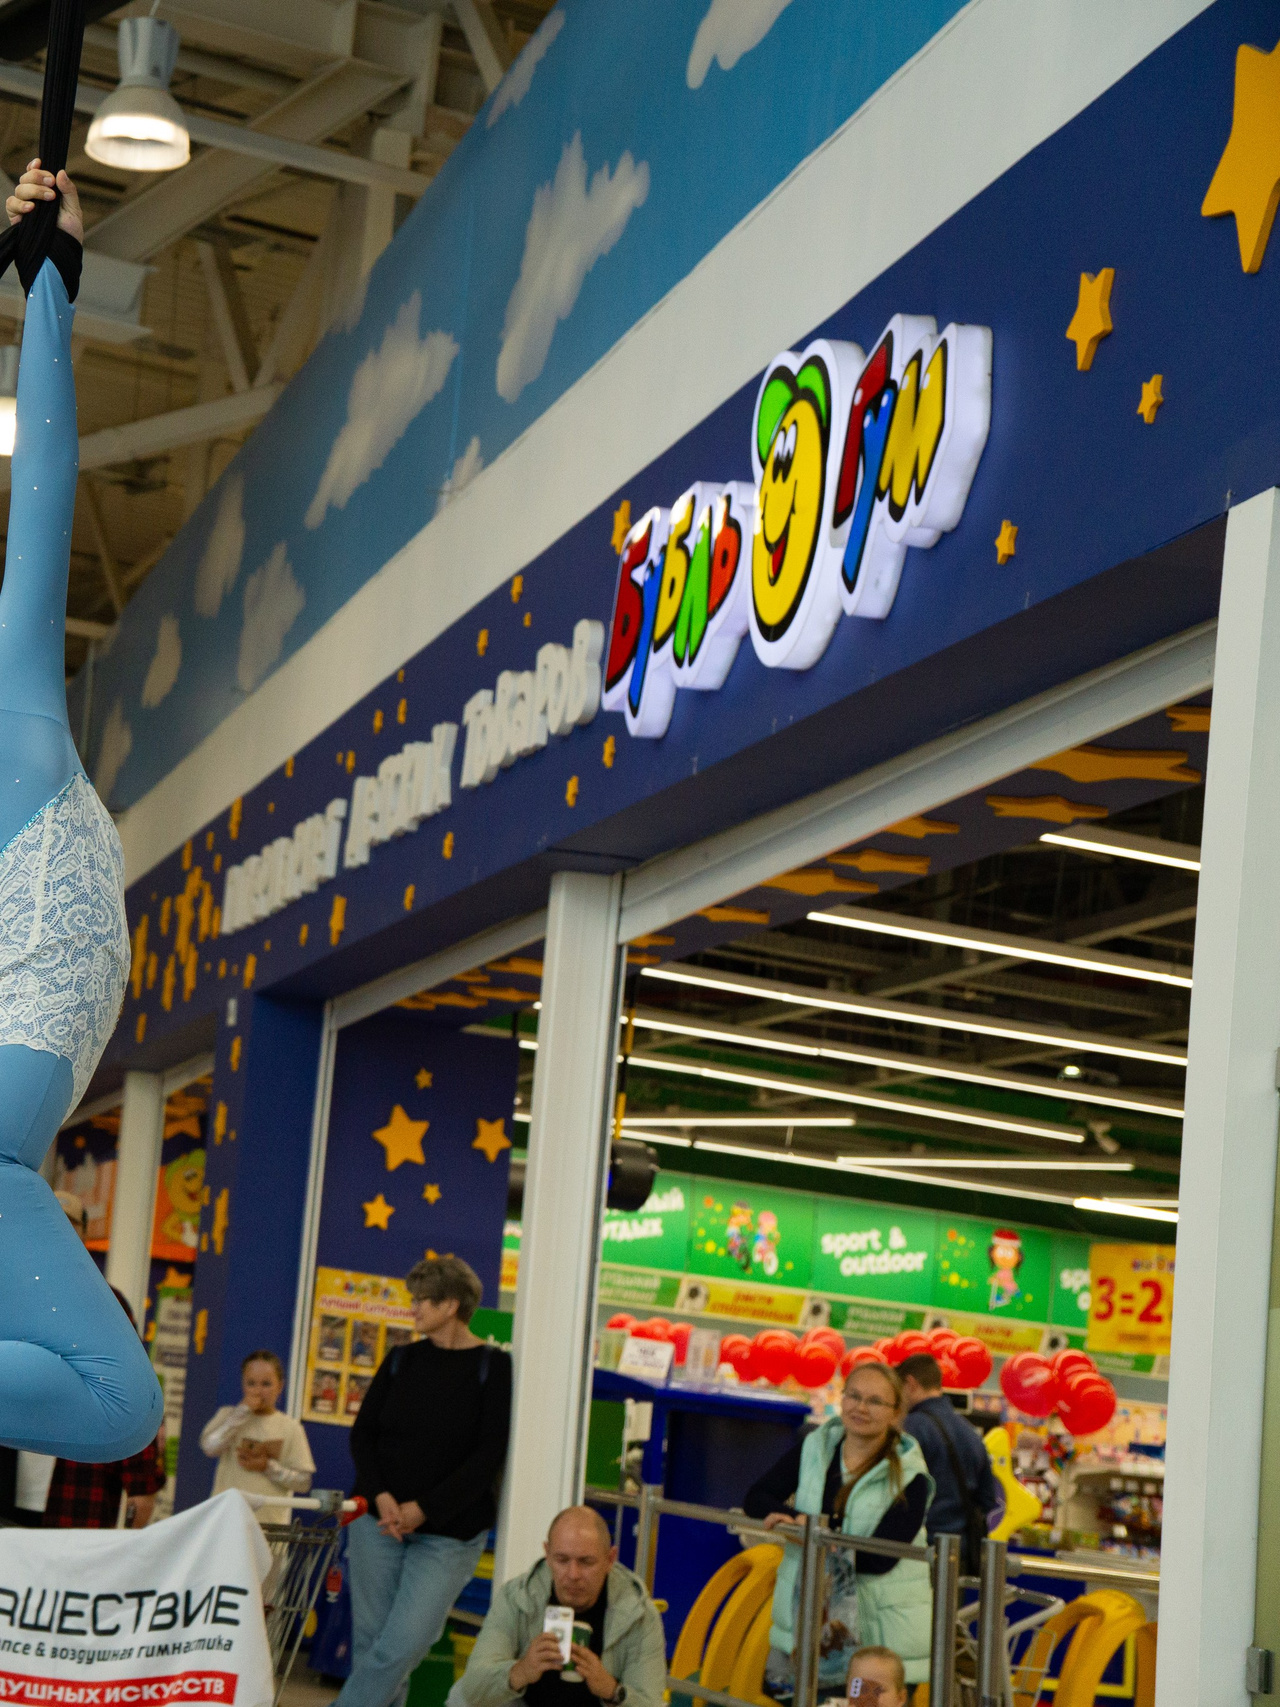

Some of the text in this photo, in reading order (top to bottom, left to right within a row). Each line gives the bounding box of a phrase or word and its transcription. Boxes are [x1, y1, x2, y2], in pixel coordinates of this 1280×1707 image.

[821, 1229, 883, 1259] sport
[840, 1249, 928, 1277] outdoor
[1094, 1276, 1164, 1323] 3=2
[35, 1643, 46, 1657] &
[104, 1677, 225, 1704] ИСКУССТВ
